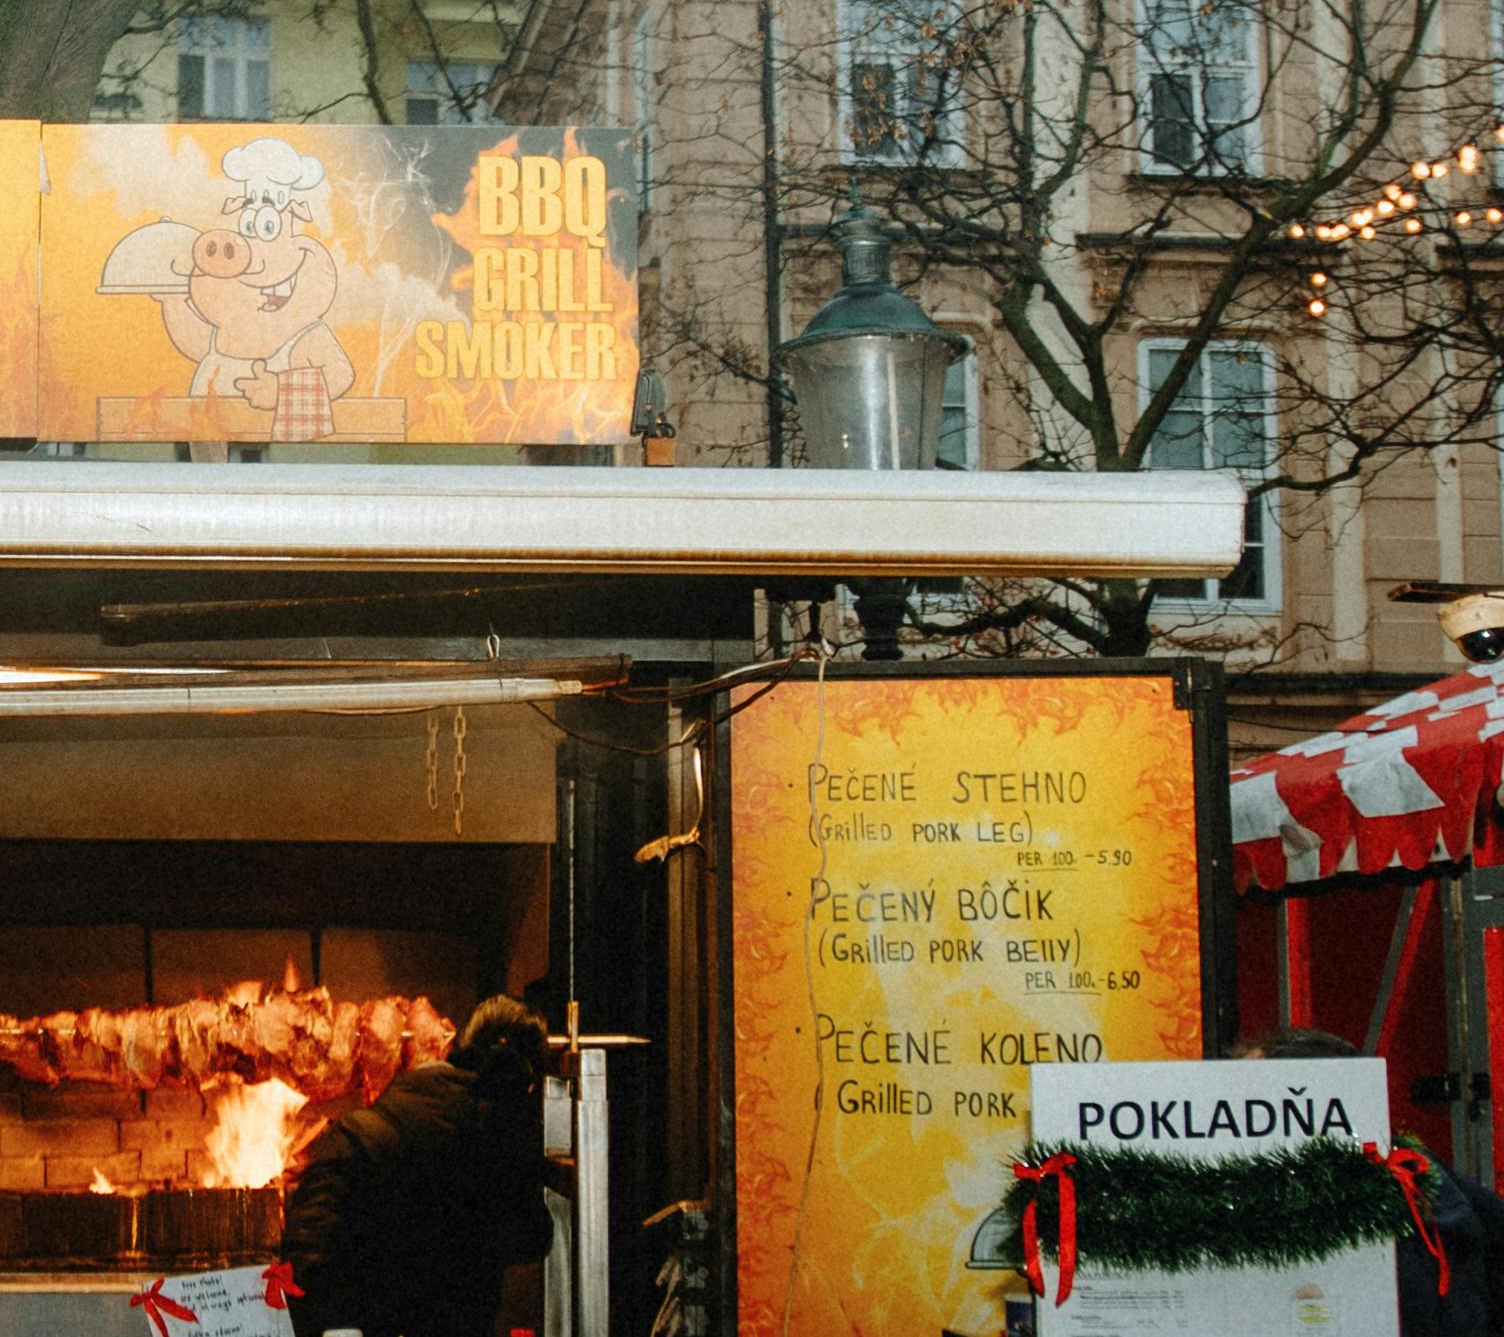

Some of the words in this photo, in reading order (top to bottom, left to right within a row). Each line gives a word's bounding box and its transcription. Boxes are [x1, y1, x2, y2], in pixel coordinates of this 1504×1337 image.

[479, 155, 607, 247] BBQ
[473, 247, 613, 312] GRILL
[415, 320, 617, 380] SMOKER
[953, 770, 1086, 804] STEHNO
[913, 822, 961, 843] PORK
[1017, 851, 1042, 867] PER
[929, 939, 984, 963] PORK
[1025, 971, 1056, 989] PER
[980, 1032, 1103, 1065] KOLENO
[955, 1091, 1017, 1117] PORK
[1078, 1086, 1353, 1141] POKLADŇA
